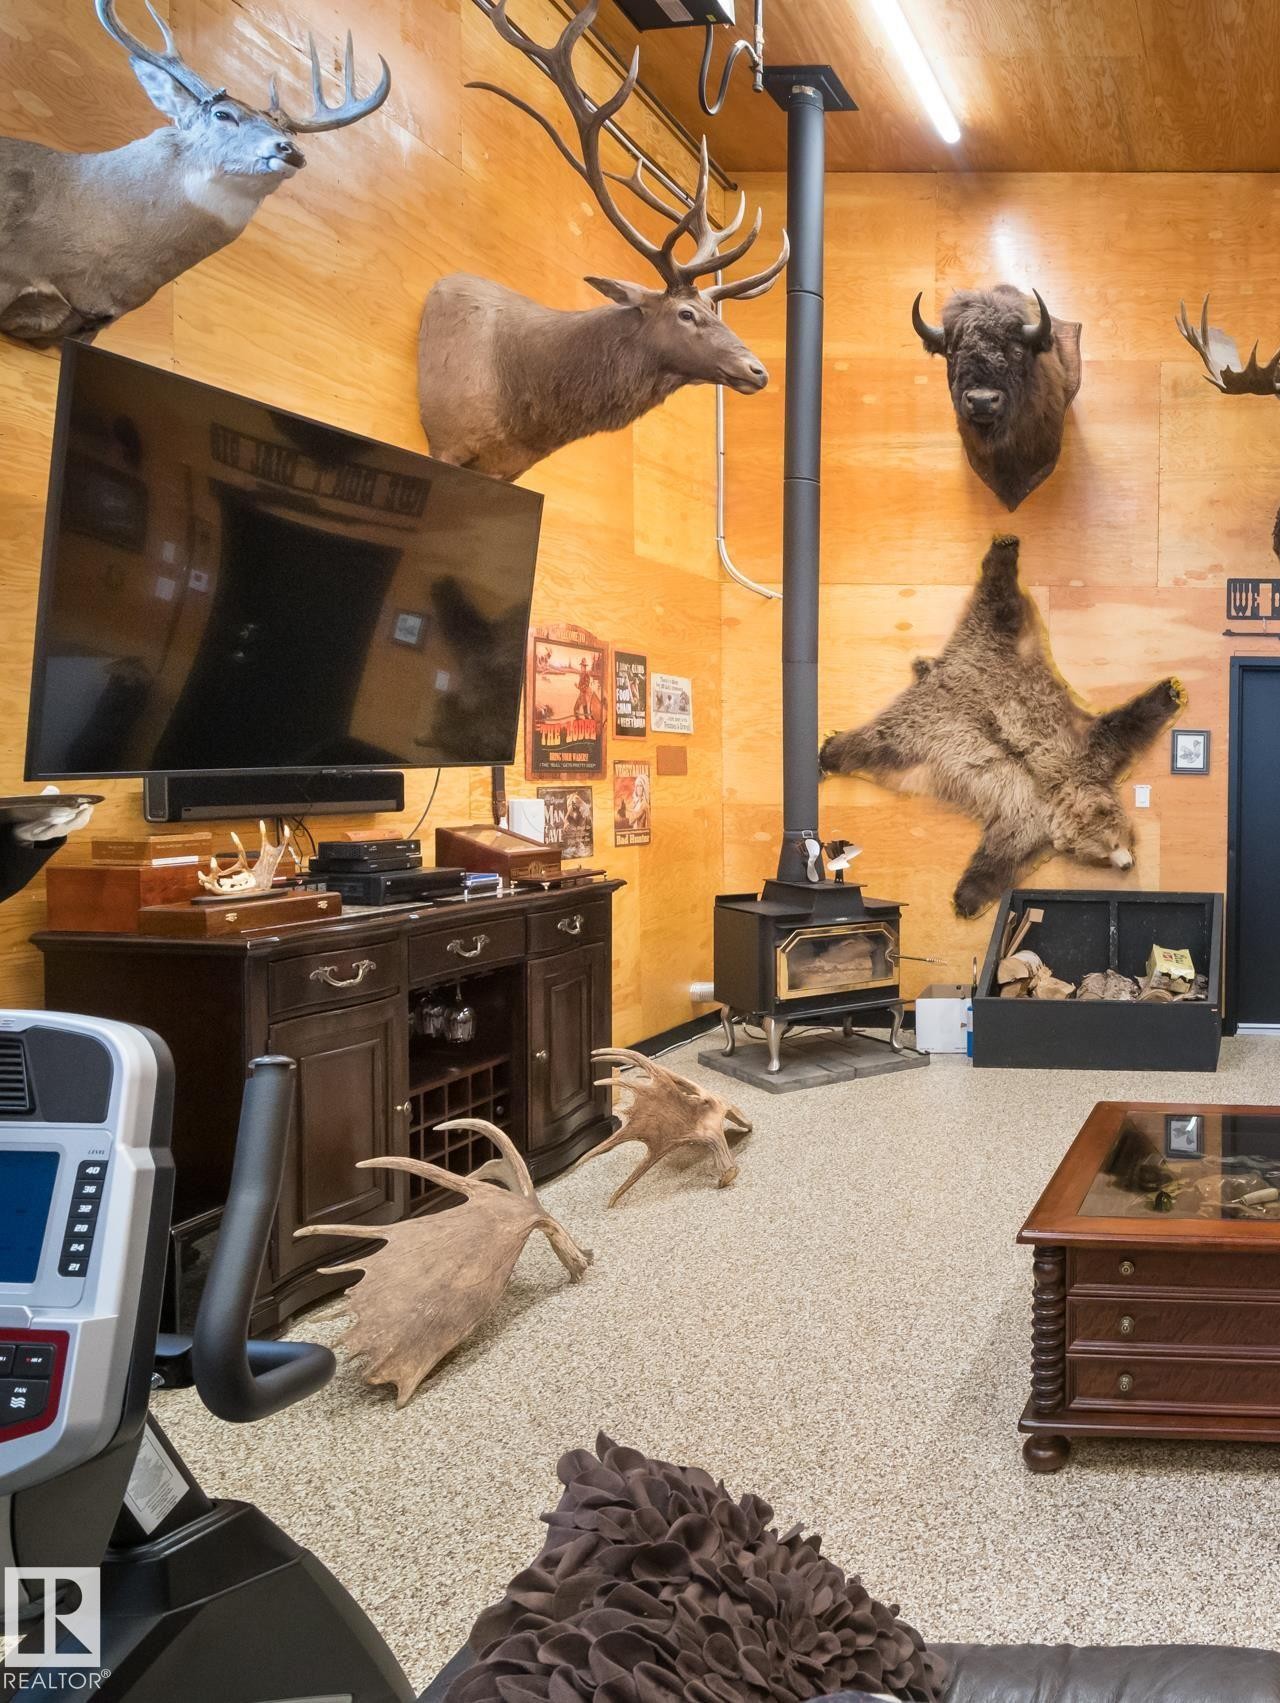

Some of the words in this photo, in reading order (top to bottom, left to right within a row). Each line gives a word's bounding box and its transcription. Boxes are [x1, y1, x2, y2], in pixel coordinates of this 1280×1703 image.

[1231, 582, 1261, 617] WE
[616, 688, 631, 702] FOOD
[616, 703, 632, 714] CHAIN
[538, 723, 561, 746] THE
[565, 719, 597, 743] LODGE
[615, 764, 649, 776] VEGETARIAN
[544, 805, 565, 827] MAN
[616, 834, 630, 846] Bad
[630, 833, 650, 845] Hunter
[85, 1166, 101, 1175] 40
[82, 1185, 97, 1194] 36
[78, 1204, 92, 1213] 32
[69, 1243, 85, 1252] 24
[68, 1262, 81, 1271] 21
